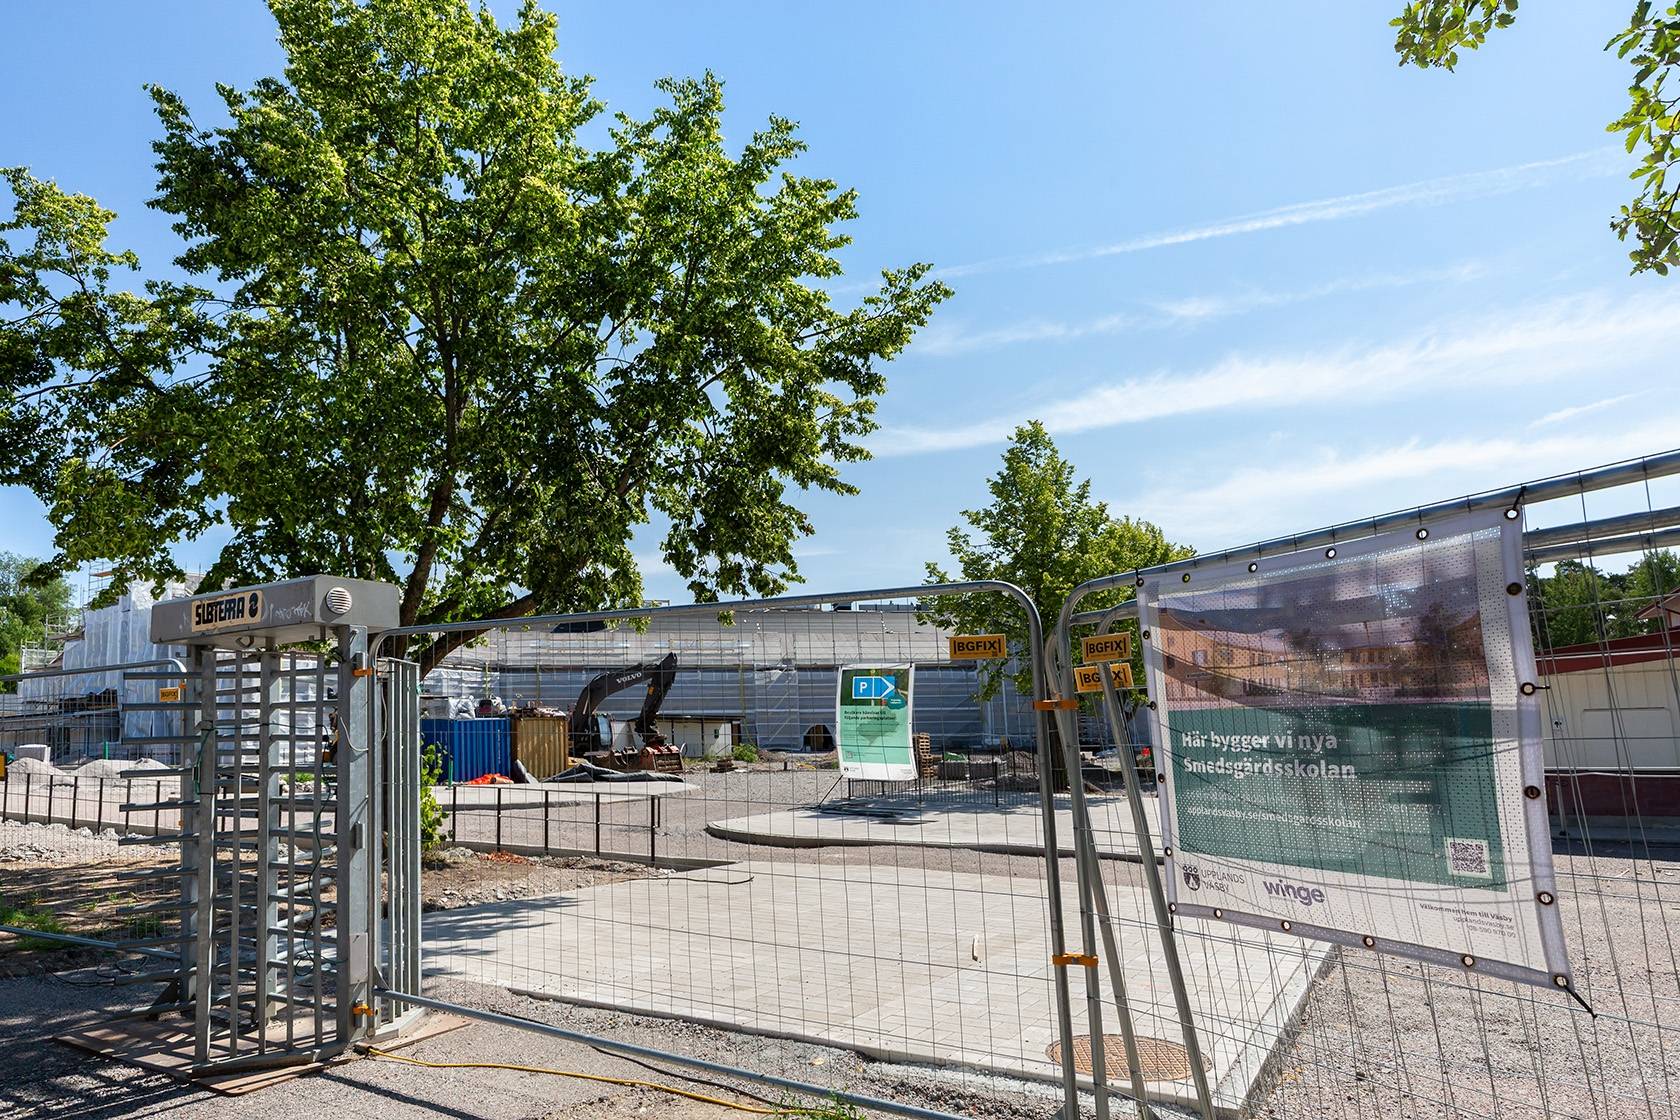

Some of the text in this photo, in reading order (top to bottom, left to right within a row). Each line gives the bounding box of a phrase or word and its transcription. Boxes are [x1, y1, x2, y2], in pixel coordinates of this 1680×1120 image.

[195, 596, 245, 626] SUBTERRA
[957, 640, 997, 652] BGFIX
[1088, 640, 1123, 654] BGFIX
[616, 672, 642, 683] VOLVO
[1083, 670, 1123, 683] BGX
[860, 682, 867, 693] P
[1181, 730, 1338, 753] Här bygger vi nya
[1183, 757, 1358, 779] Smedsgärdsskolan
[1201, 869, 1246, 885] UPPLANDS
[1263, 879, 1326, 906] winge
